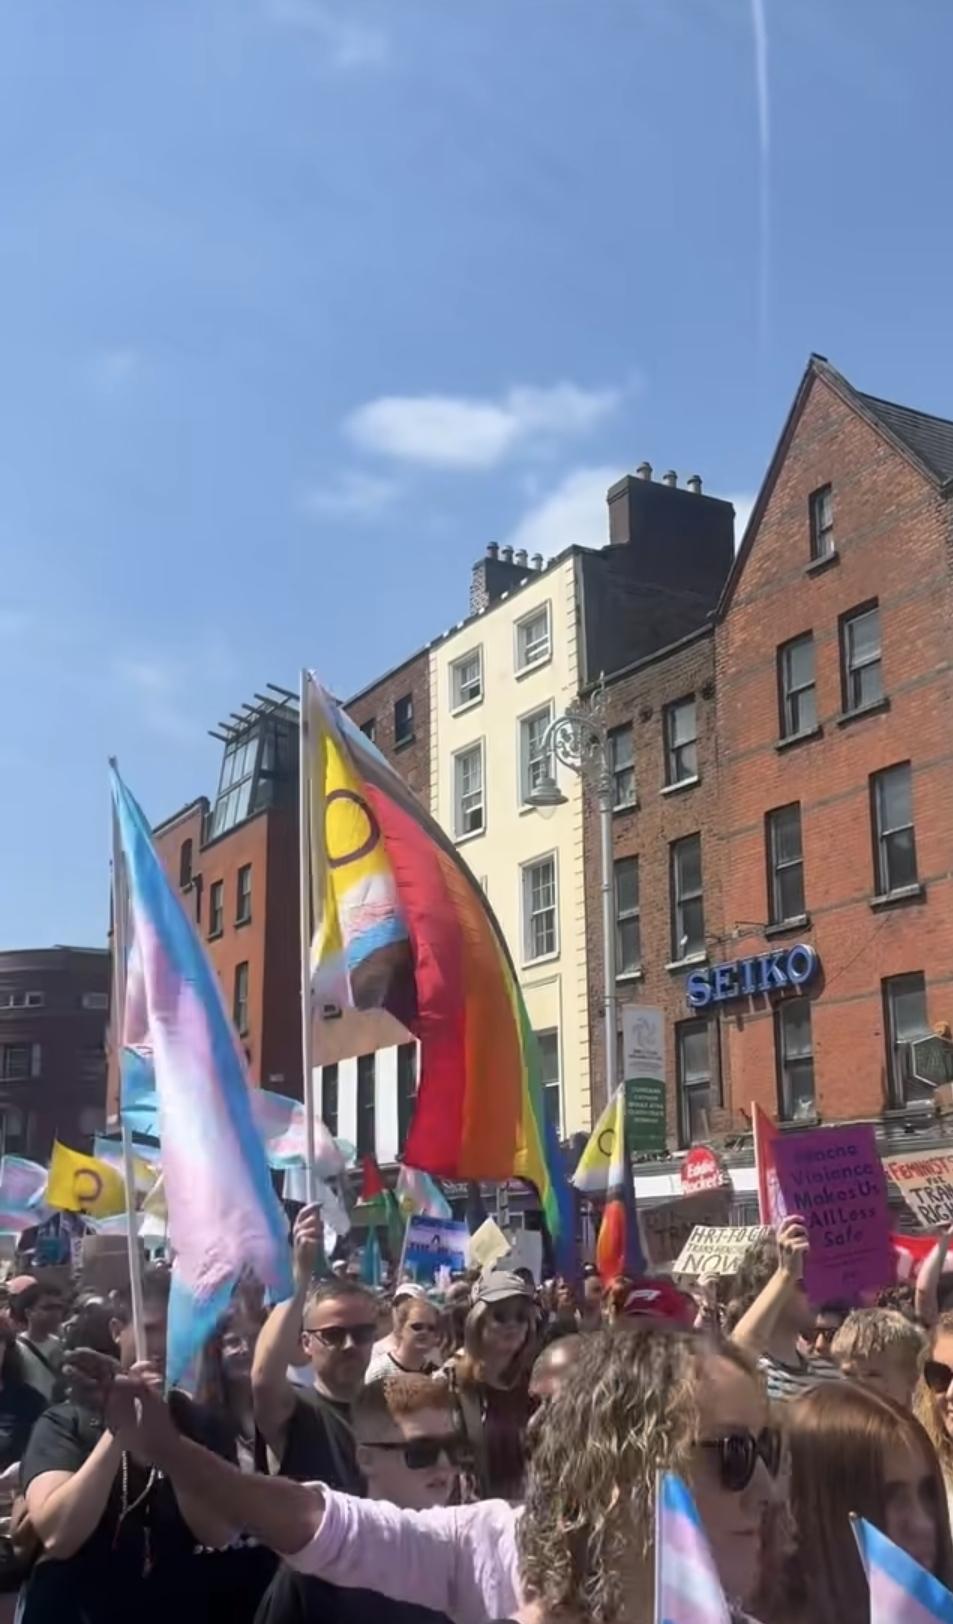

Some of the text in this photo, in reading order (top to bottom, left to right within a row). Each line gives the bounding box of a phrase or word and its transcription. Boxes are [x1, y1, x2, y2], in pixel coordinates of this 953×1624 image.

[687, 943, 816, 1007] SEIKO
[794, 1180, 880, 1210] Makes Us
[809, 1207, 876, 1229] All Less
[824, 1224, 863, 1248] Safe
[681, 1253, 739, 1272] NOW
